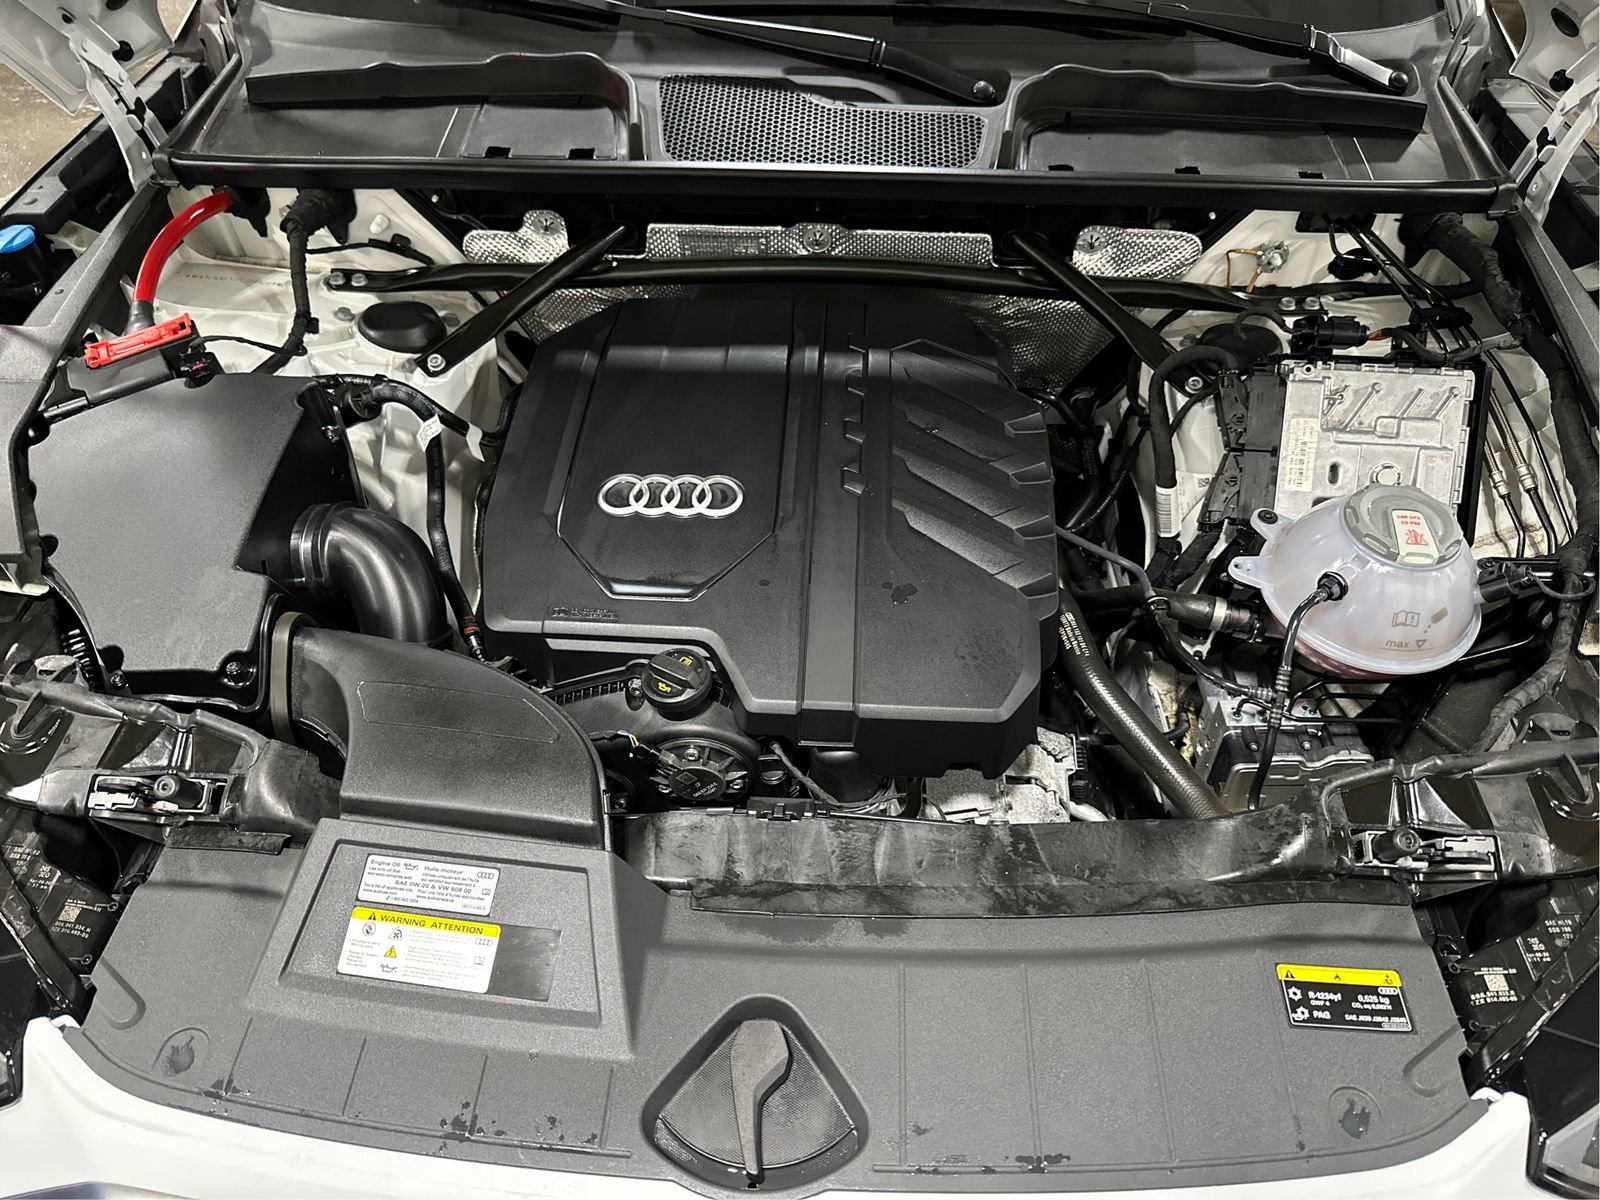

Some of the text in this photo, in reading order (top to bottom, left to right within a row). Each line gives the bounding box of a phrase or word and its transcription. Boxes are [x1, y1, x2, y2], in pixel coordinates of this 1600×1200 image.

[1385, 639, 1410, 648] max
[380, 914, 484, 935] WARNING ATTENTION
[1378, 996, 1390, 1004] kg
[1312, 1010, 1331, 1019] PAG
